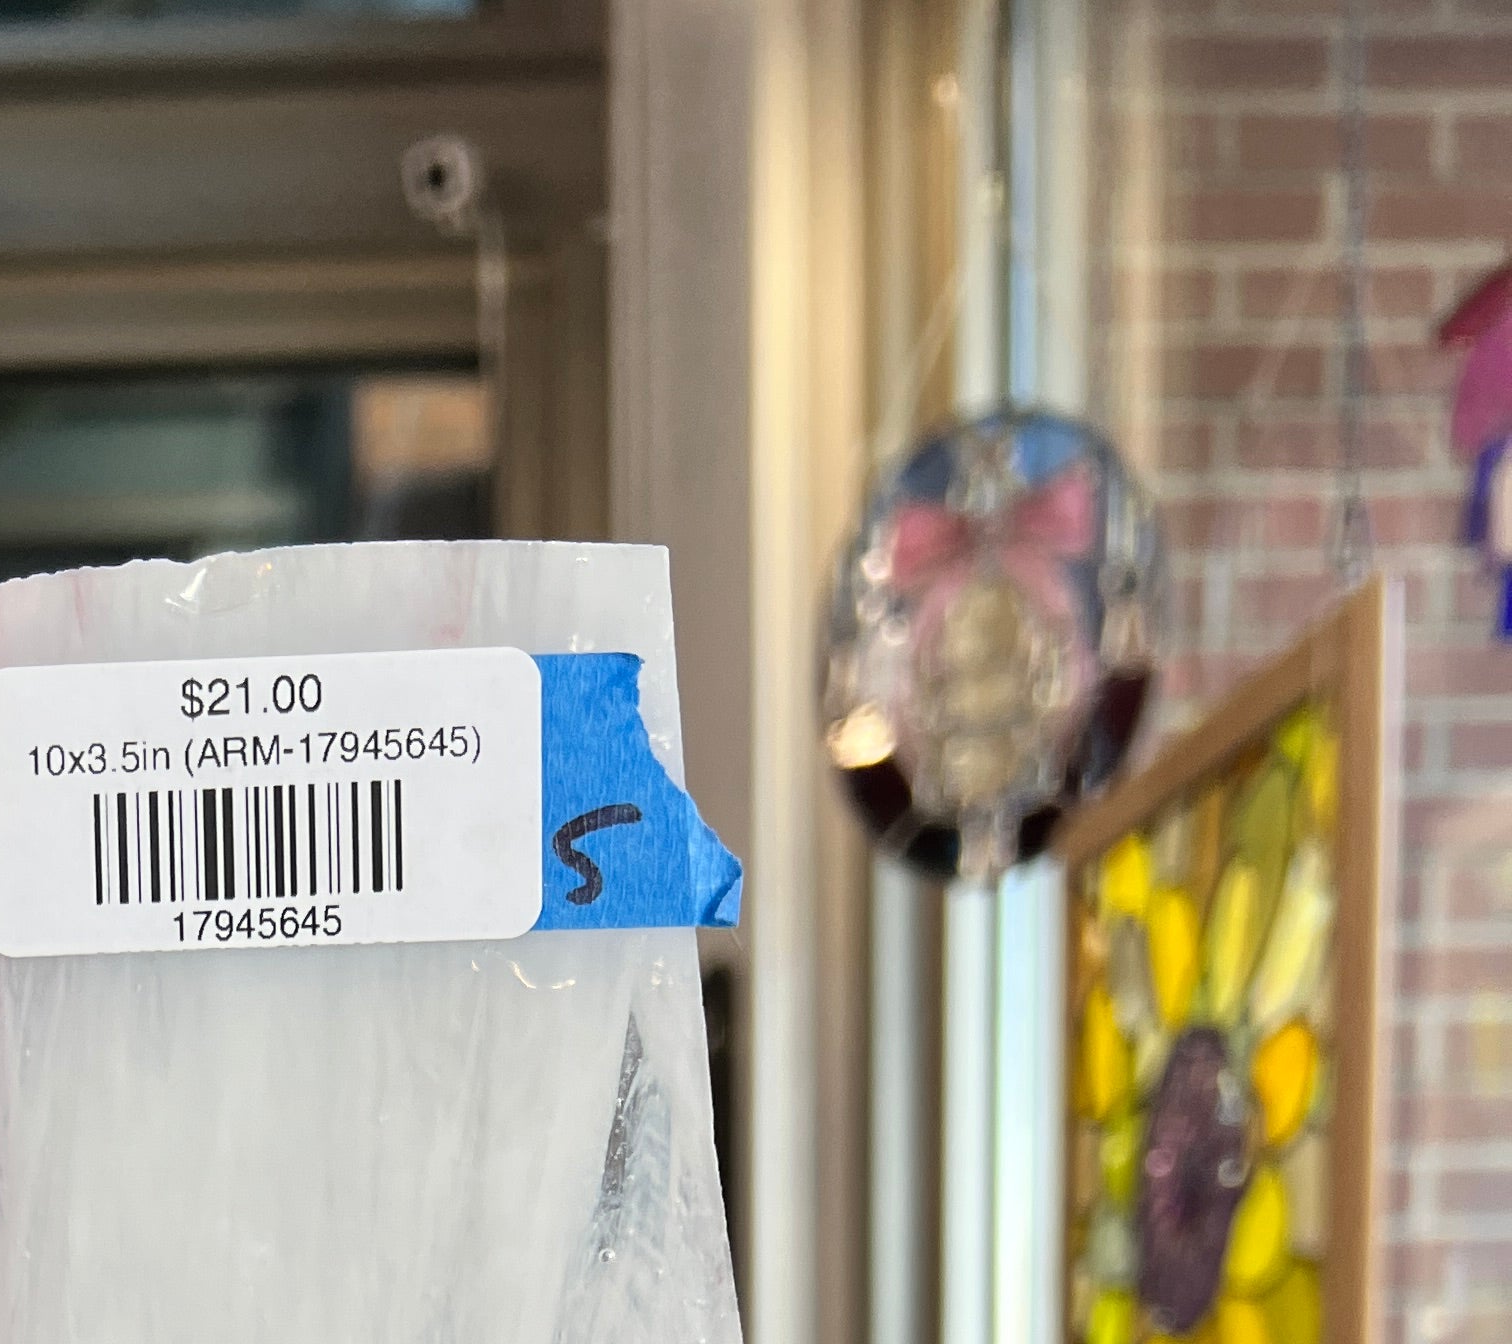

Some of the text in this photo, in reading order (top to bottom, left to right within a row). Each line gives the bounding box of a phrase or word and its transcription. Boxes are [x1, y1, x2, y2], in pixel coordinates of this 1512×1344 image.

[180, 673, 323, 720] $21.00
[27, 726, 482, 777] 10x3.5in (ARM-17945645)
[173, 904, 343, 943] 17945645
